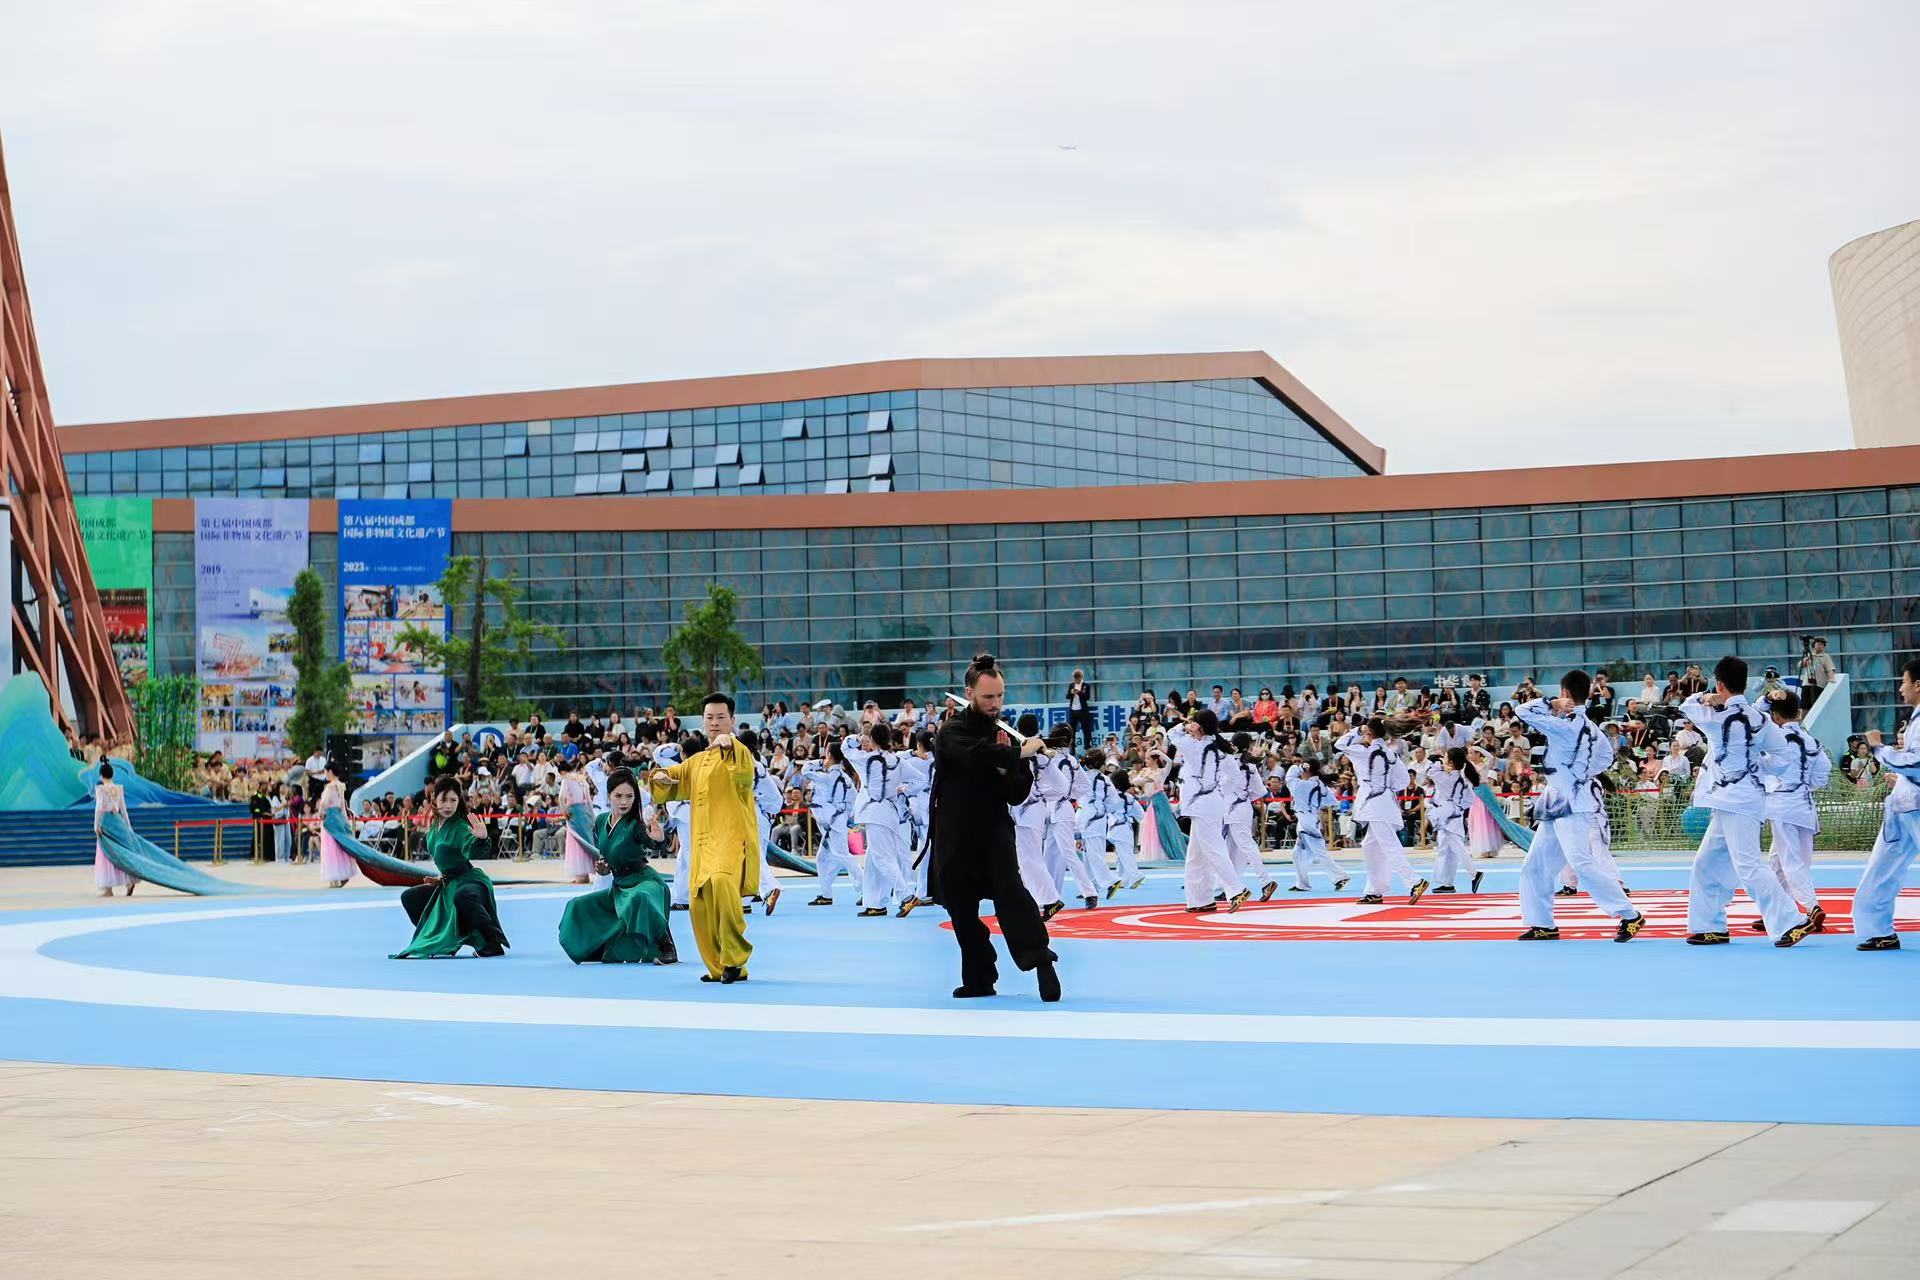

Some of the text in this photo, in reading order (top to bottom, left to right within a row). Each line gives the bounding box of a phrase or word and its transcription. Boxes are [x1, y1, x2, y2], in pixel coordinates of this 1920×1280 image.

[200, 518, 273, 528] 第七届中国成都
[343, 515, 416, 526] 第八届中国成都
[81, 529, 147, 540] 质文化遗产节
[200, 530, 303, 541] 国际非物质文化遗产节
[343, 527, 446, 539] 国际非物质文化遗产节
[200, 564, 221, 574] 2019
[343, 561, 365, 572] 2023
